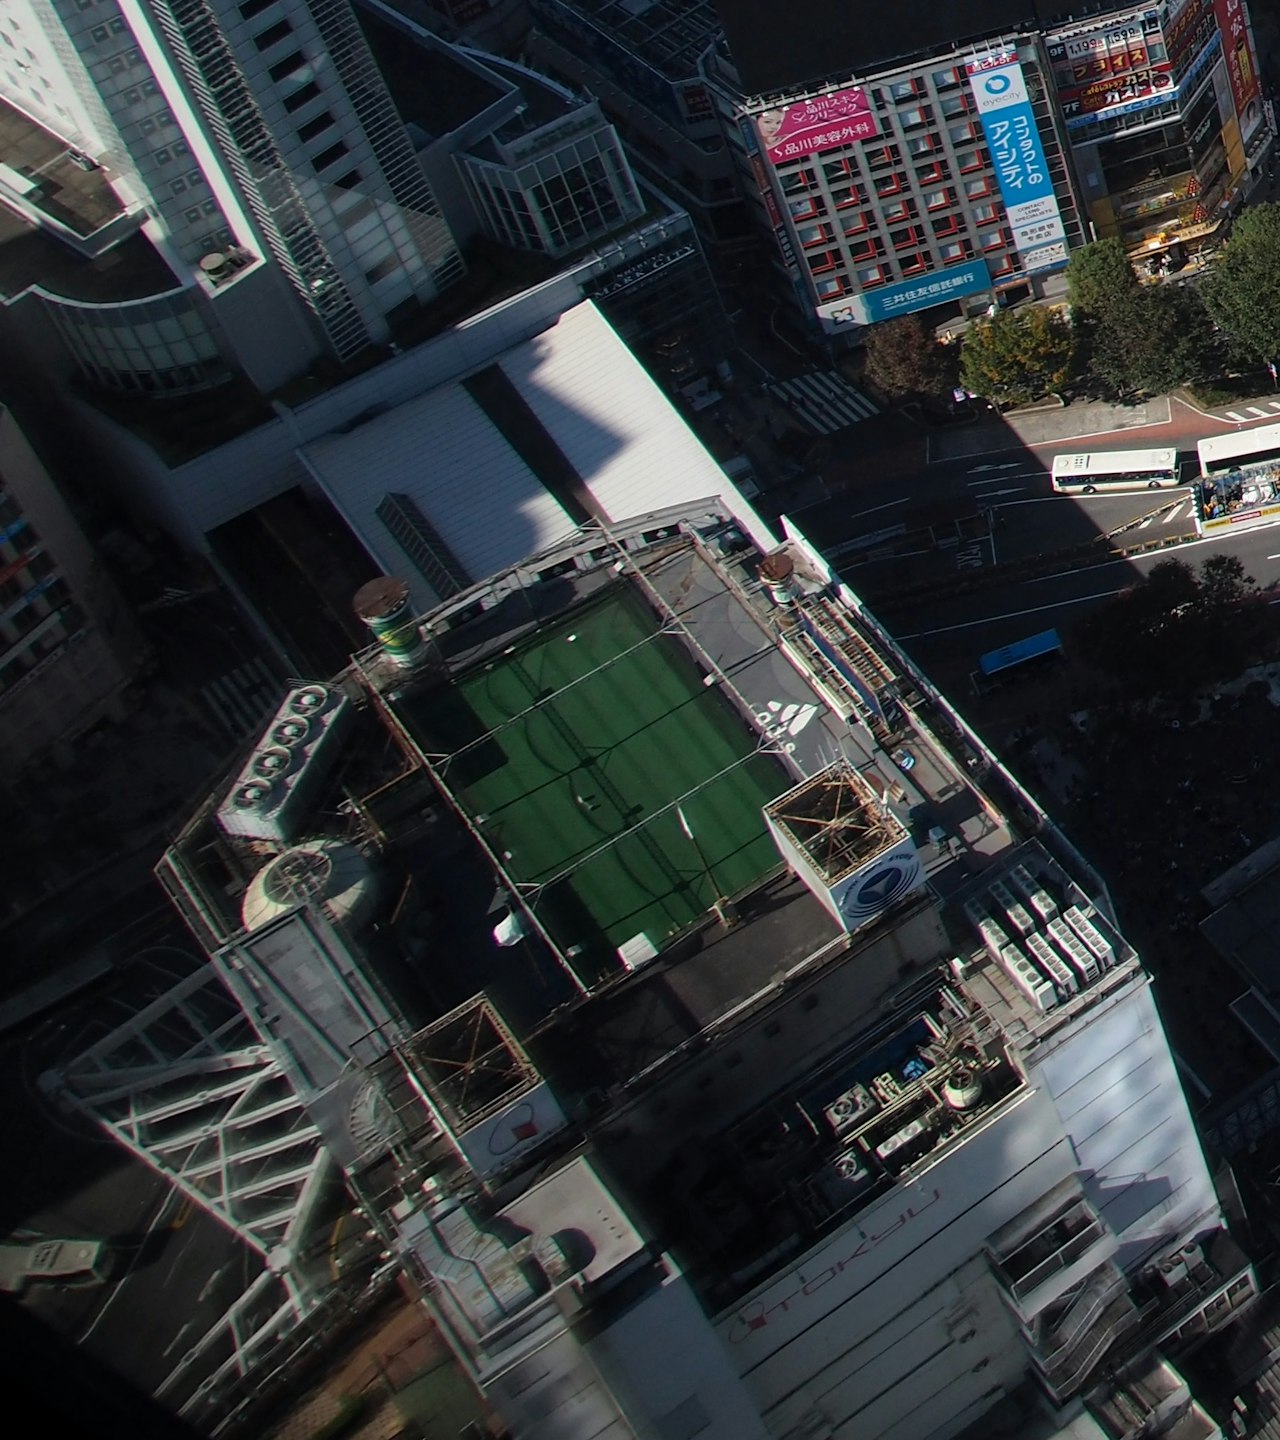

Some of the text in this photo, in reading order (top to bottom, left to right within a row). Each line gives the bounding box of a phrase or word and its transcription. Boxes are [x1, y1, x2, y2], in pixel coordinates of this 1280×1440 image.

[805, 91, 861, 116] 品川スキン
[982, 91, 1021, 108] eyecity
[1062, 101, 1080, 114] 7F
[1104, 84, 1147, 105] ガスト
[808, 103, 858, 125] クリニック
[783, 122, 872, 156] 品川美容外科
[1012, 115, 1043, 185] コンタクトの
[989, 120, 1023, 189] アイシティ
[1017, 201, 1045, 213] CONTACT
[594, 270, 645, 299] MARK
[652, 244, 694, 269] CITY
[881, 271, 975, 308] 三井住友信託銀行
[778, 1188, 941, 1316] TOKYU
